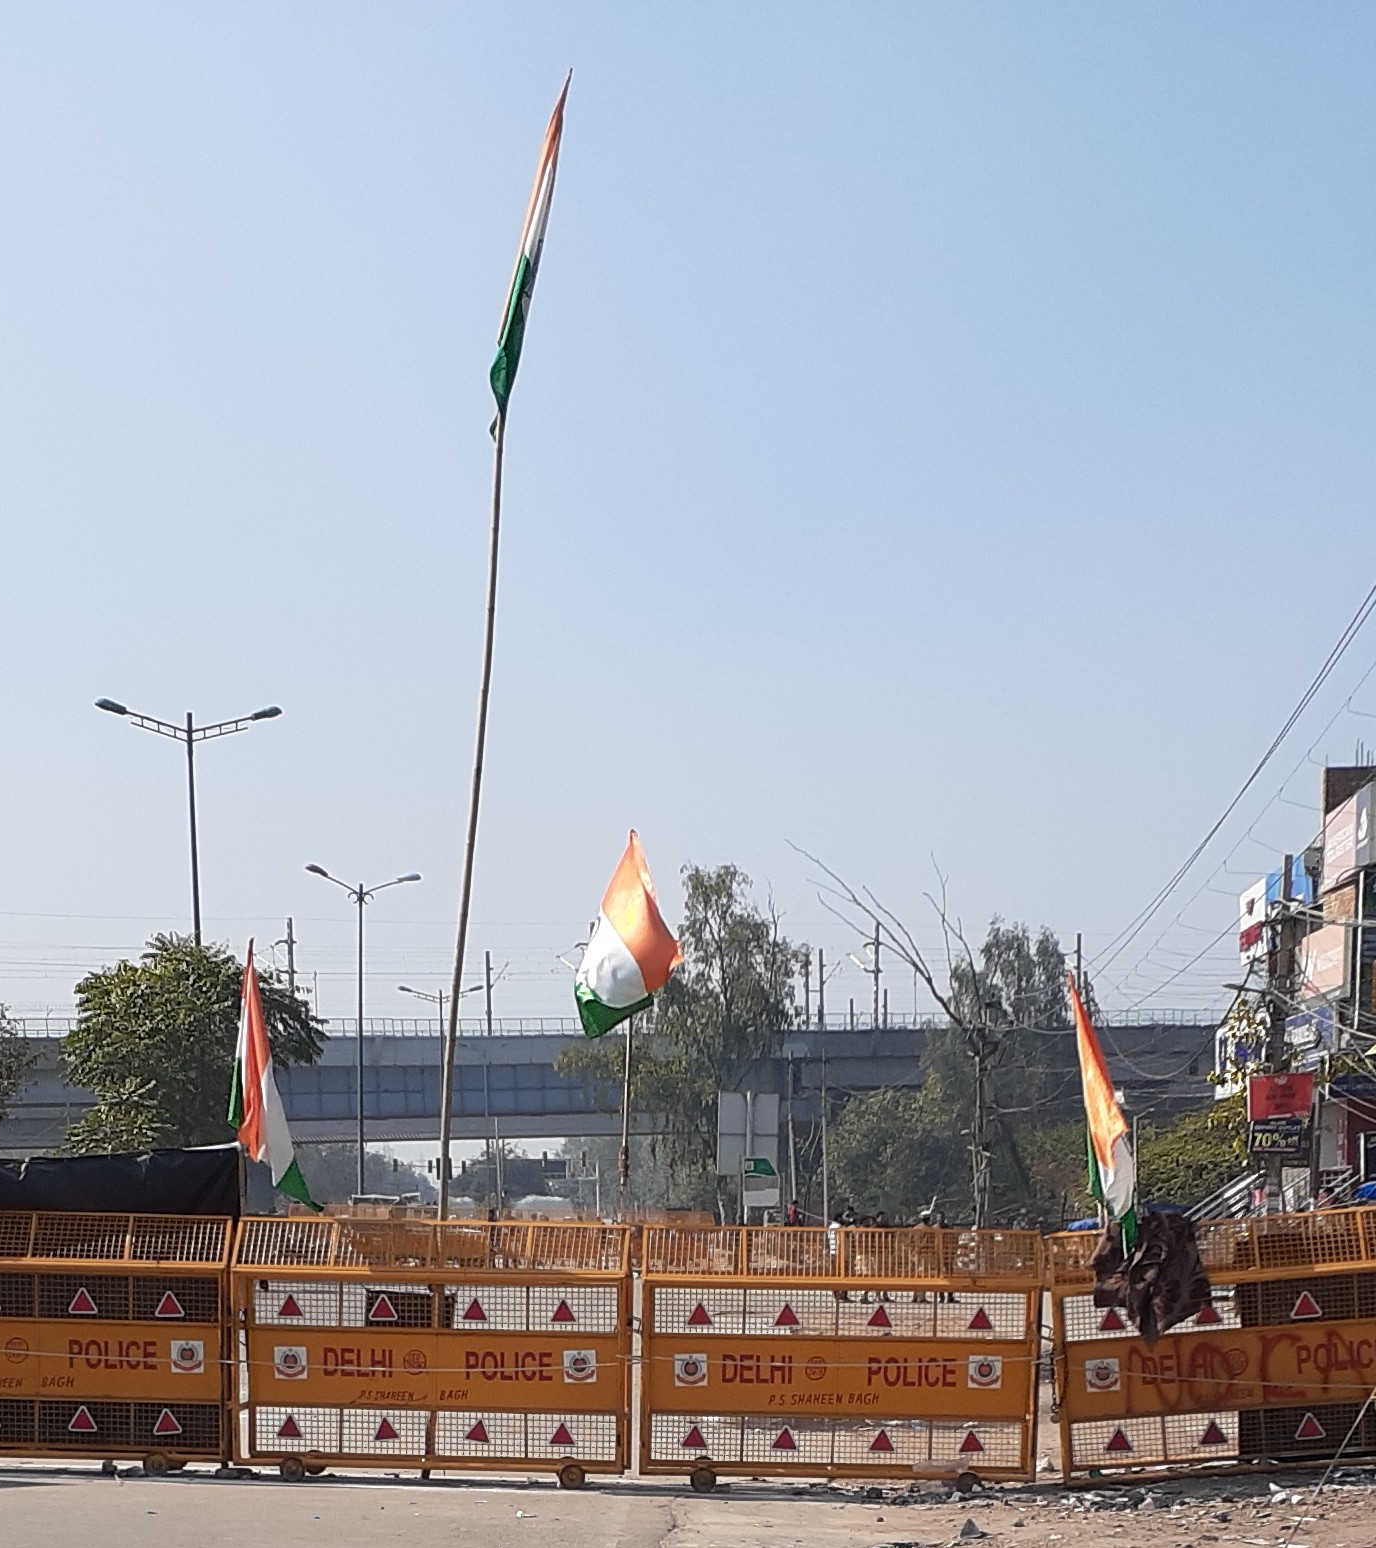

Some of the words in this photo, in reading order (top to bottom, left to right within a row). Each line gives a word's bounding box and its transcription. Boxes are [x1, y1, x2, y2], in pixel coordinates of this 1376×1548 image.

[1254, 1132, 1286, 1147] 70%
[68, 1339, 157, 1370] POLICE
[323, 1347, 393, 1377] DELHI
[466, 1351, 554, 1382] POLICE
[720, 1354, 792, 1384] DELHI
[867, 1357, 957, 1388] POLICE
[41, 1376, 74, 1388] BAGH
[439, 1389, 469, 1401] BAGH
[790, 1393, 843, 1406] SHAHEEN
[848, 1392, 880, 1405] BAGH
